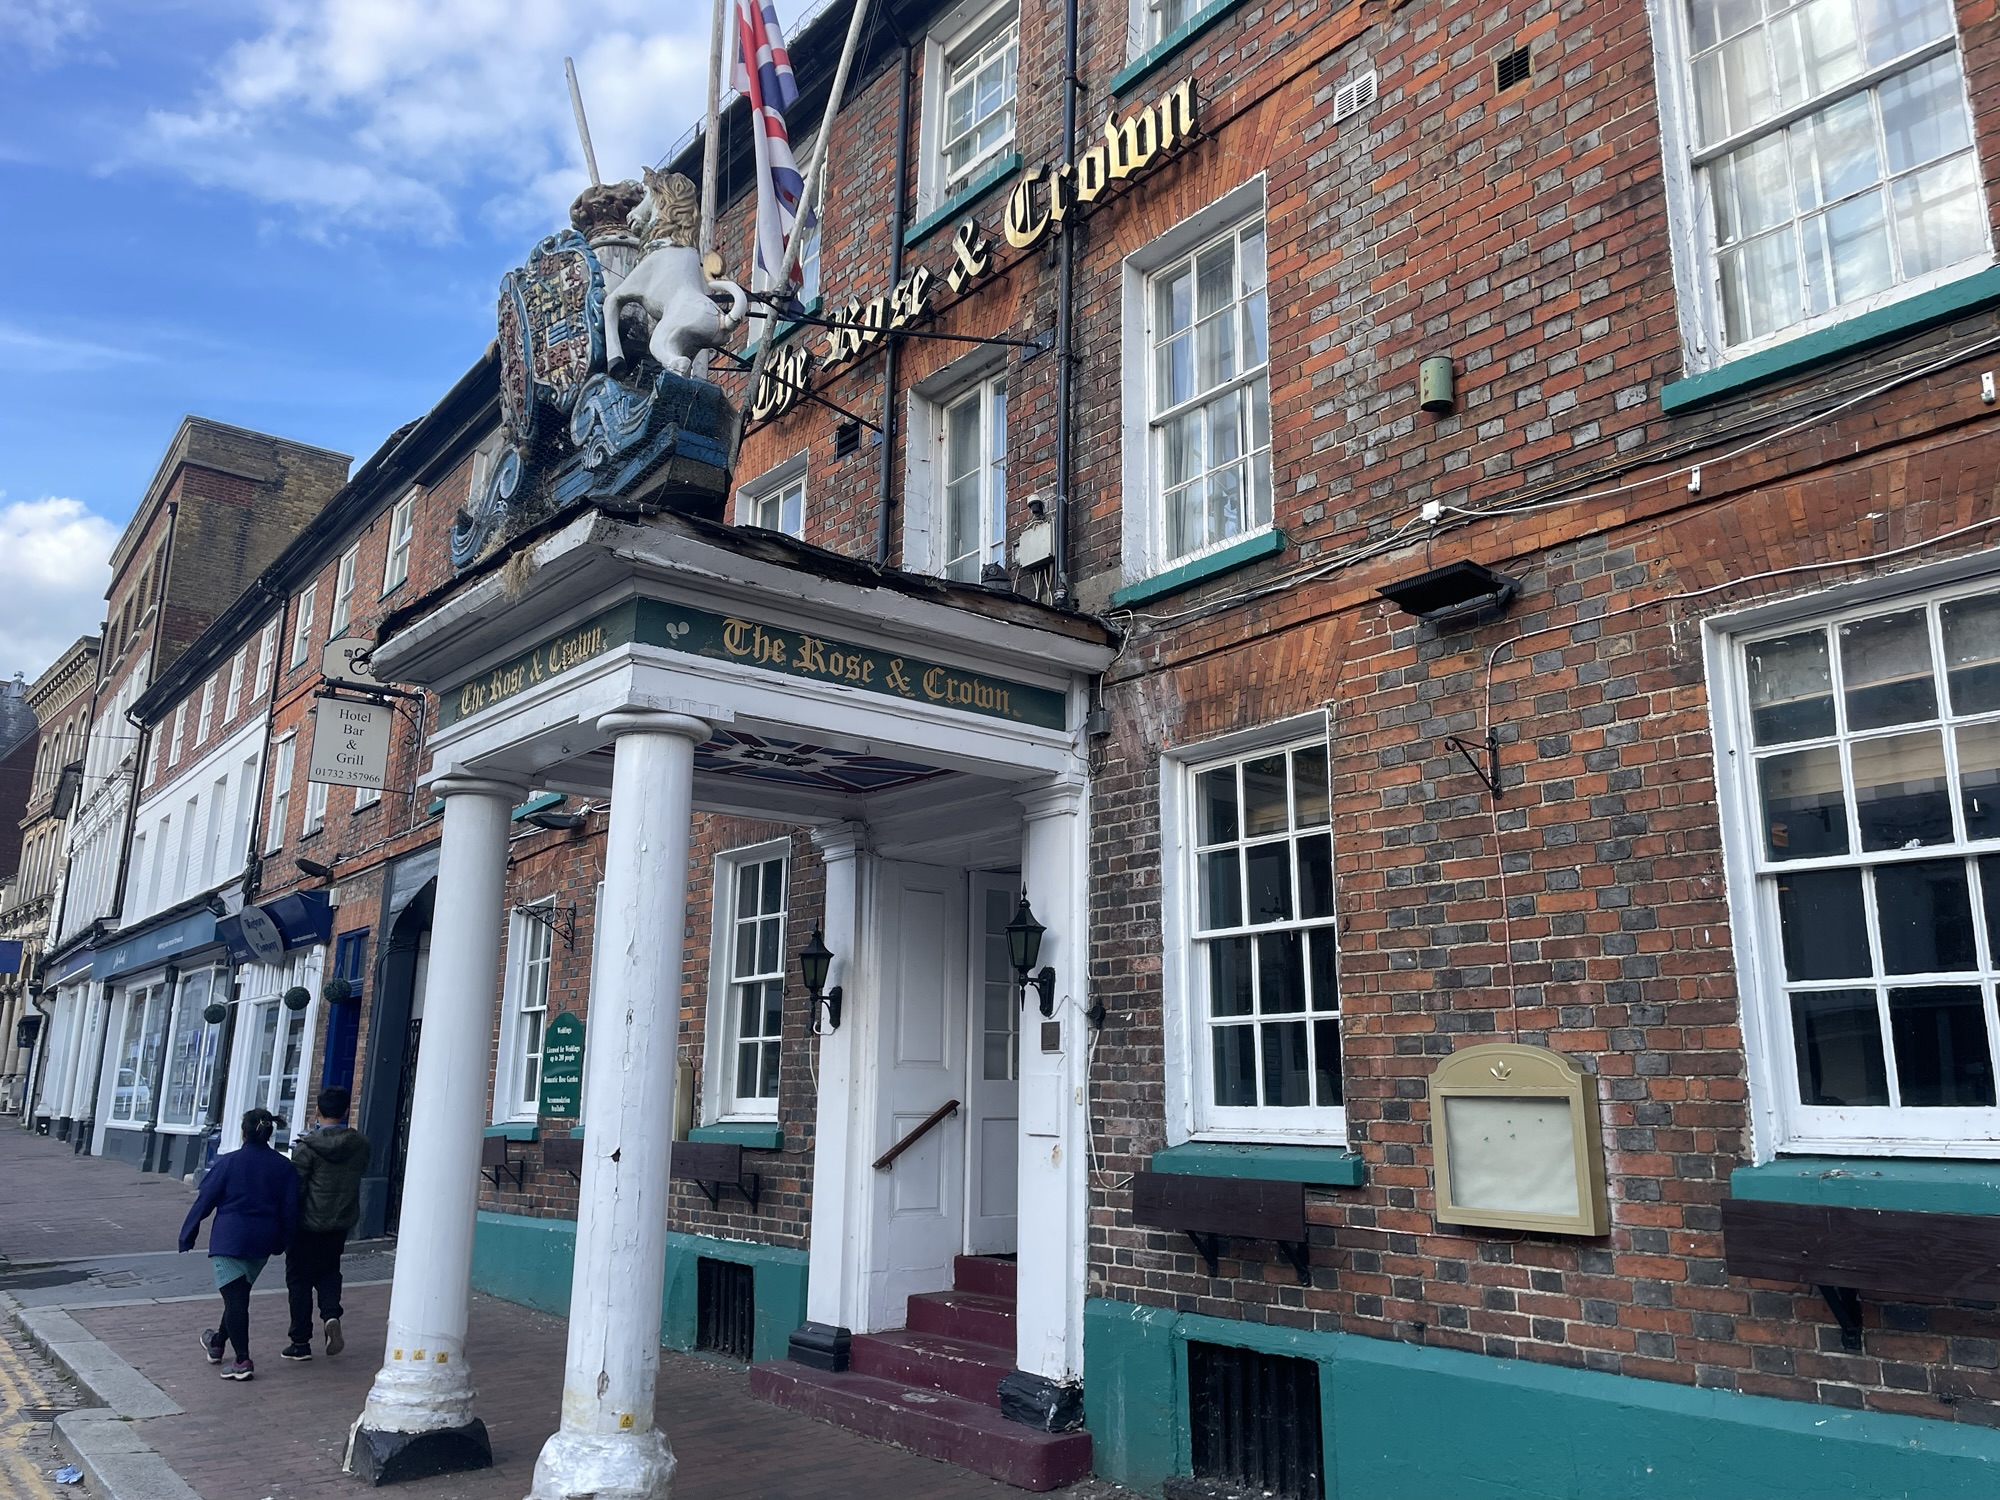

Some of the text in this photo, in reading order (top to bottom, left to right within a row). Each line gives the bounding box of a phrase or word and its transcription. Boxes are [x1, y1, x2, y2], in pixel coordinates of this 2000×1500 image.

[752, 76, 1198, 422] The Rose & Crown
[722, 618, 787, 664] The
[792, 635, 875, 684] Rose
[885, 658, 912, 692] &
[460, 683, 486, 716] The
[489, 668, 526, 704] Rose
[529, 650, 544, 684] &
[339, 708, 372, 723] Hotel
[343, 724, 365, 736] Bar
[346, 739, 357, 750] &
[336, 752, 364, 766] Grill
[315, 767, 381, 783] 01732 357966
